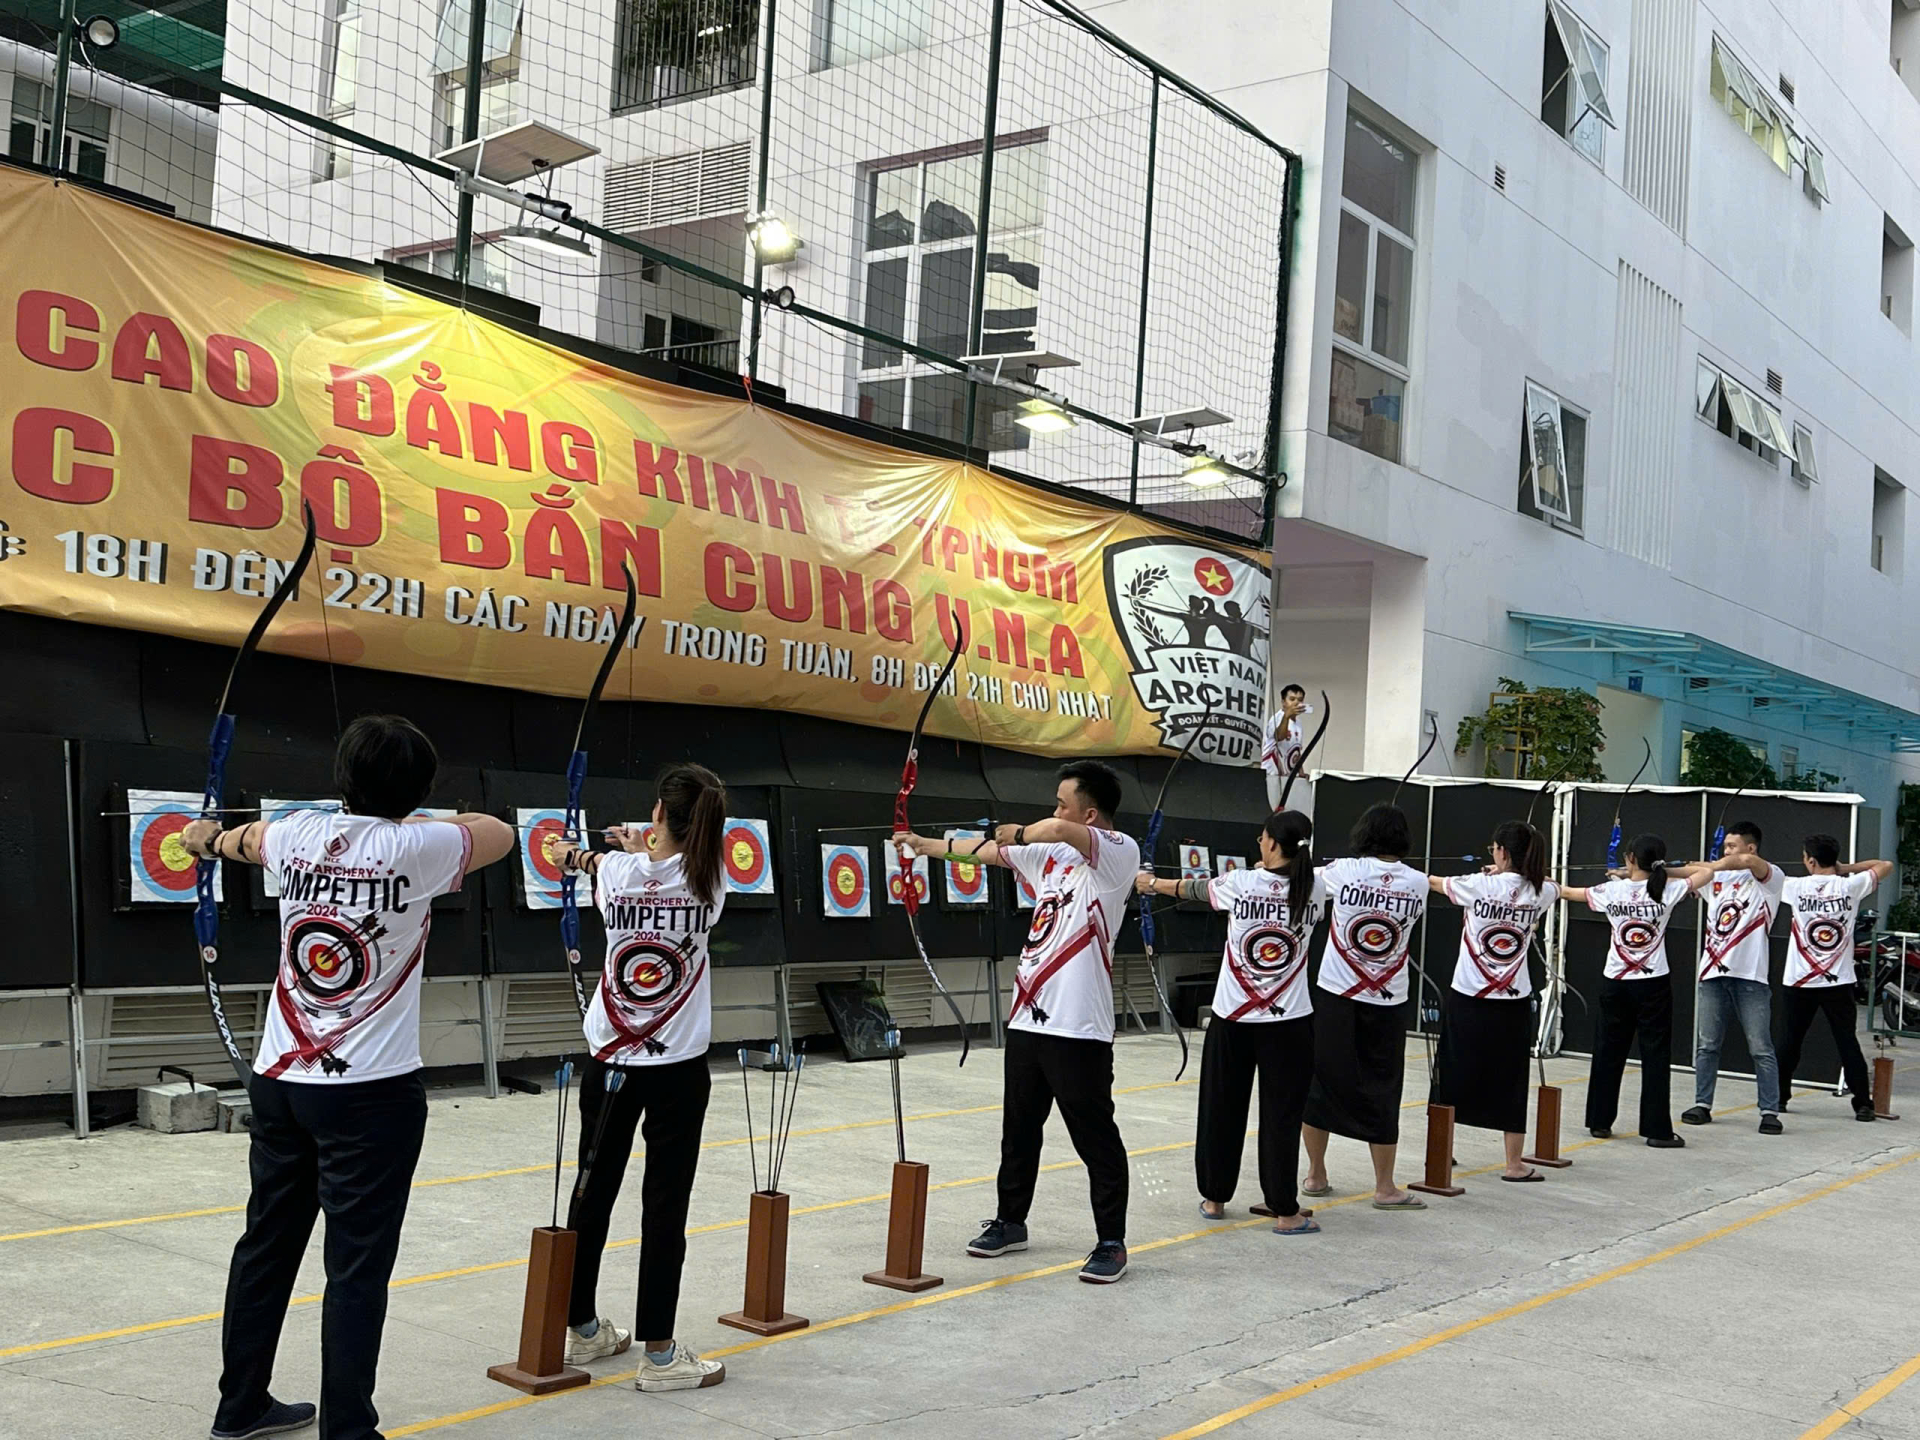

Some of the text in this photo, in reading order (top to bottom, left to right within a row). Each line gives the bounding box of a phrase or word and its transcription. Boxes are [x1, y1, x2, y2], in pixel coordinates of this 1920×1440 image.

[16, 290, 279, 408] CAO
[325, 360, 600, 485] ĐẲNG
[633, 439, 807, 535] KINH
[913, 517, 1079, 604] TPHCM
[189, 434, 382, 564] BỘ
[436, 483, 662, 598] BẮN
[704, 541, 914, 644] CUNG
[54, 530, 168, 584] 18H
[323, 567, 425, 618] 22H
[445, 586, 529, 633] CÁC
[661, 619, 767, 667] TRONG
[871, 655, 905, 688] 8H
[966, 672, 1004, 705] 21H
[1057, 690, 1113, 722] NHẬT
[1169, 652, 1219, 678] VIỆT
[1199, 732, 1253, 760] CLUB
[313, 864, 375, 878] ARCHERY
[1375, 888, 1410, 898] ARCHERY
[636, 897, 690, 906] ARCHERY
[1340, 884, 1422, 919] COMPETTIC
[306, 903, 338, 918] 2024
[1370, 909, 1390, 918] 2024
[1263, 920, 1282, 928] 2024
[634, 931, 661, 941] 2024
